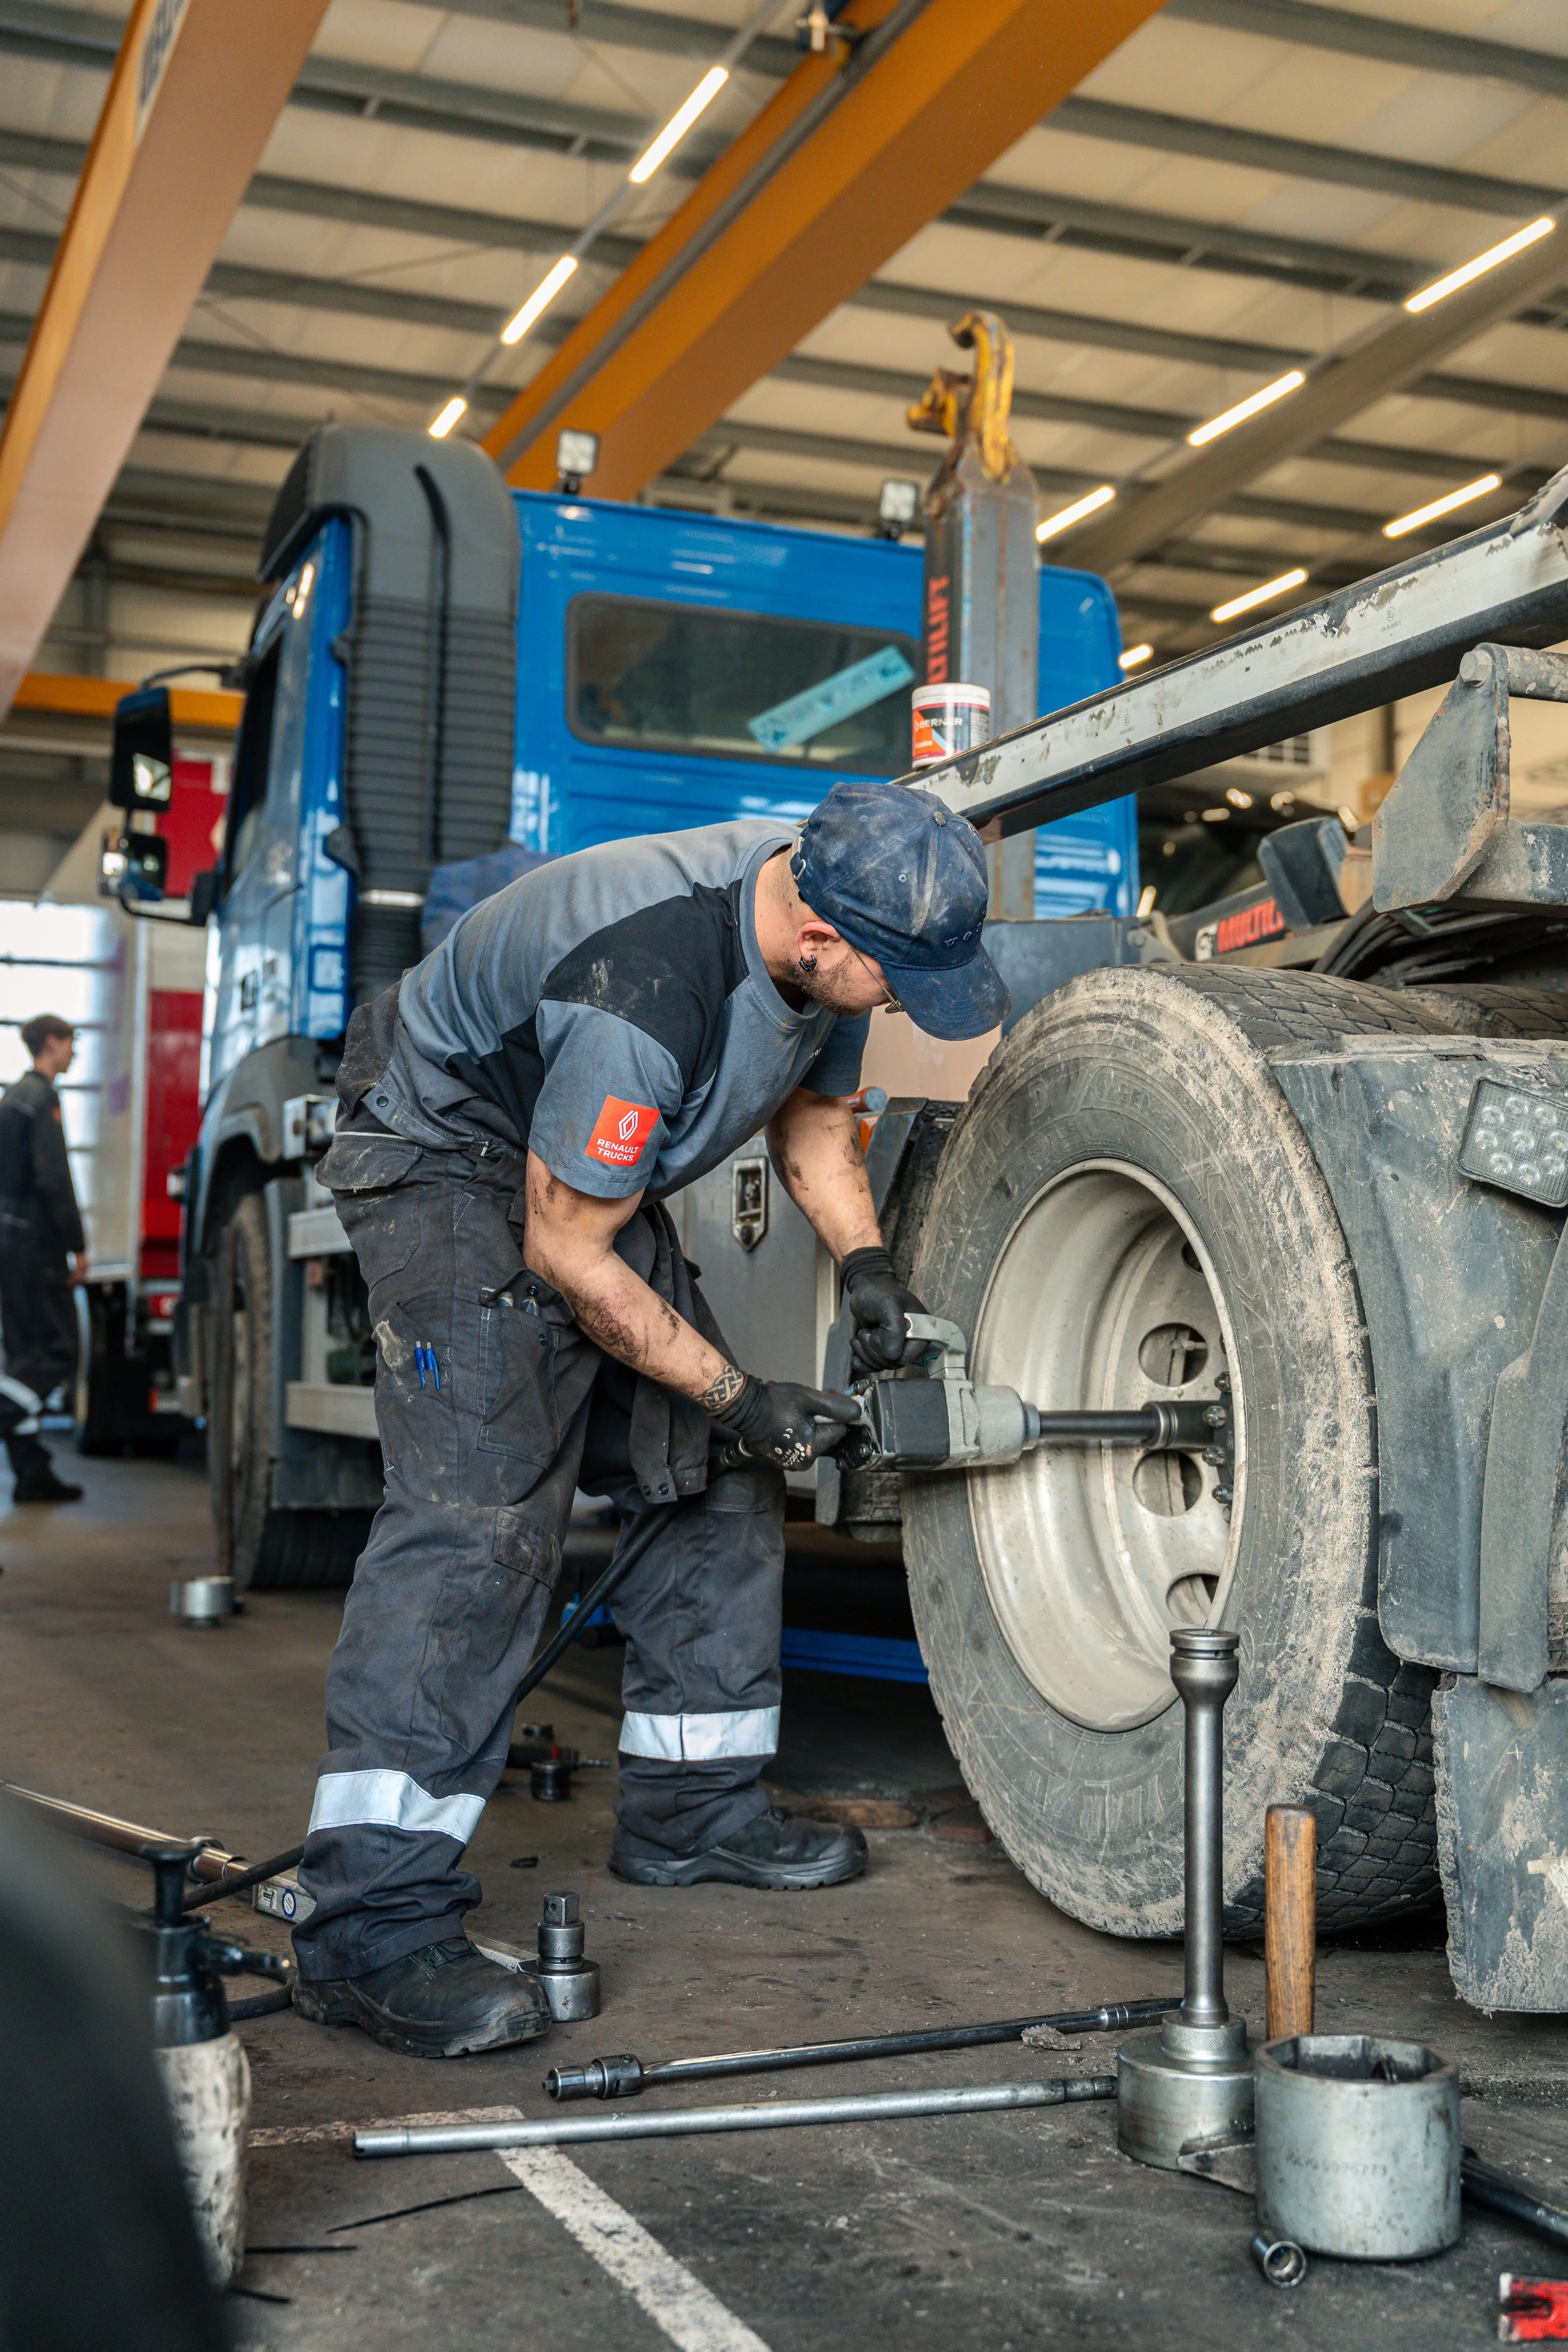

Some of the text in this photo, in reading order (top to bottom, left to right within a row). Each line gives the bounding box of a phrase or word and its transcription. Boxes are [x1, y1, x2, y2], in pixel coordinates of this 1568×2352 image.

[919, 716, 963, 729] BERNER
[596, 1138, 638, 1154] RENAULT
[597, 1147, 634, 1161] TRUCKS
